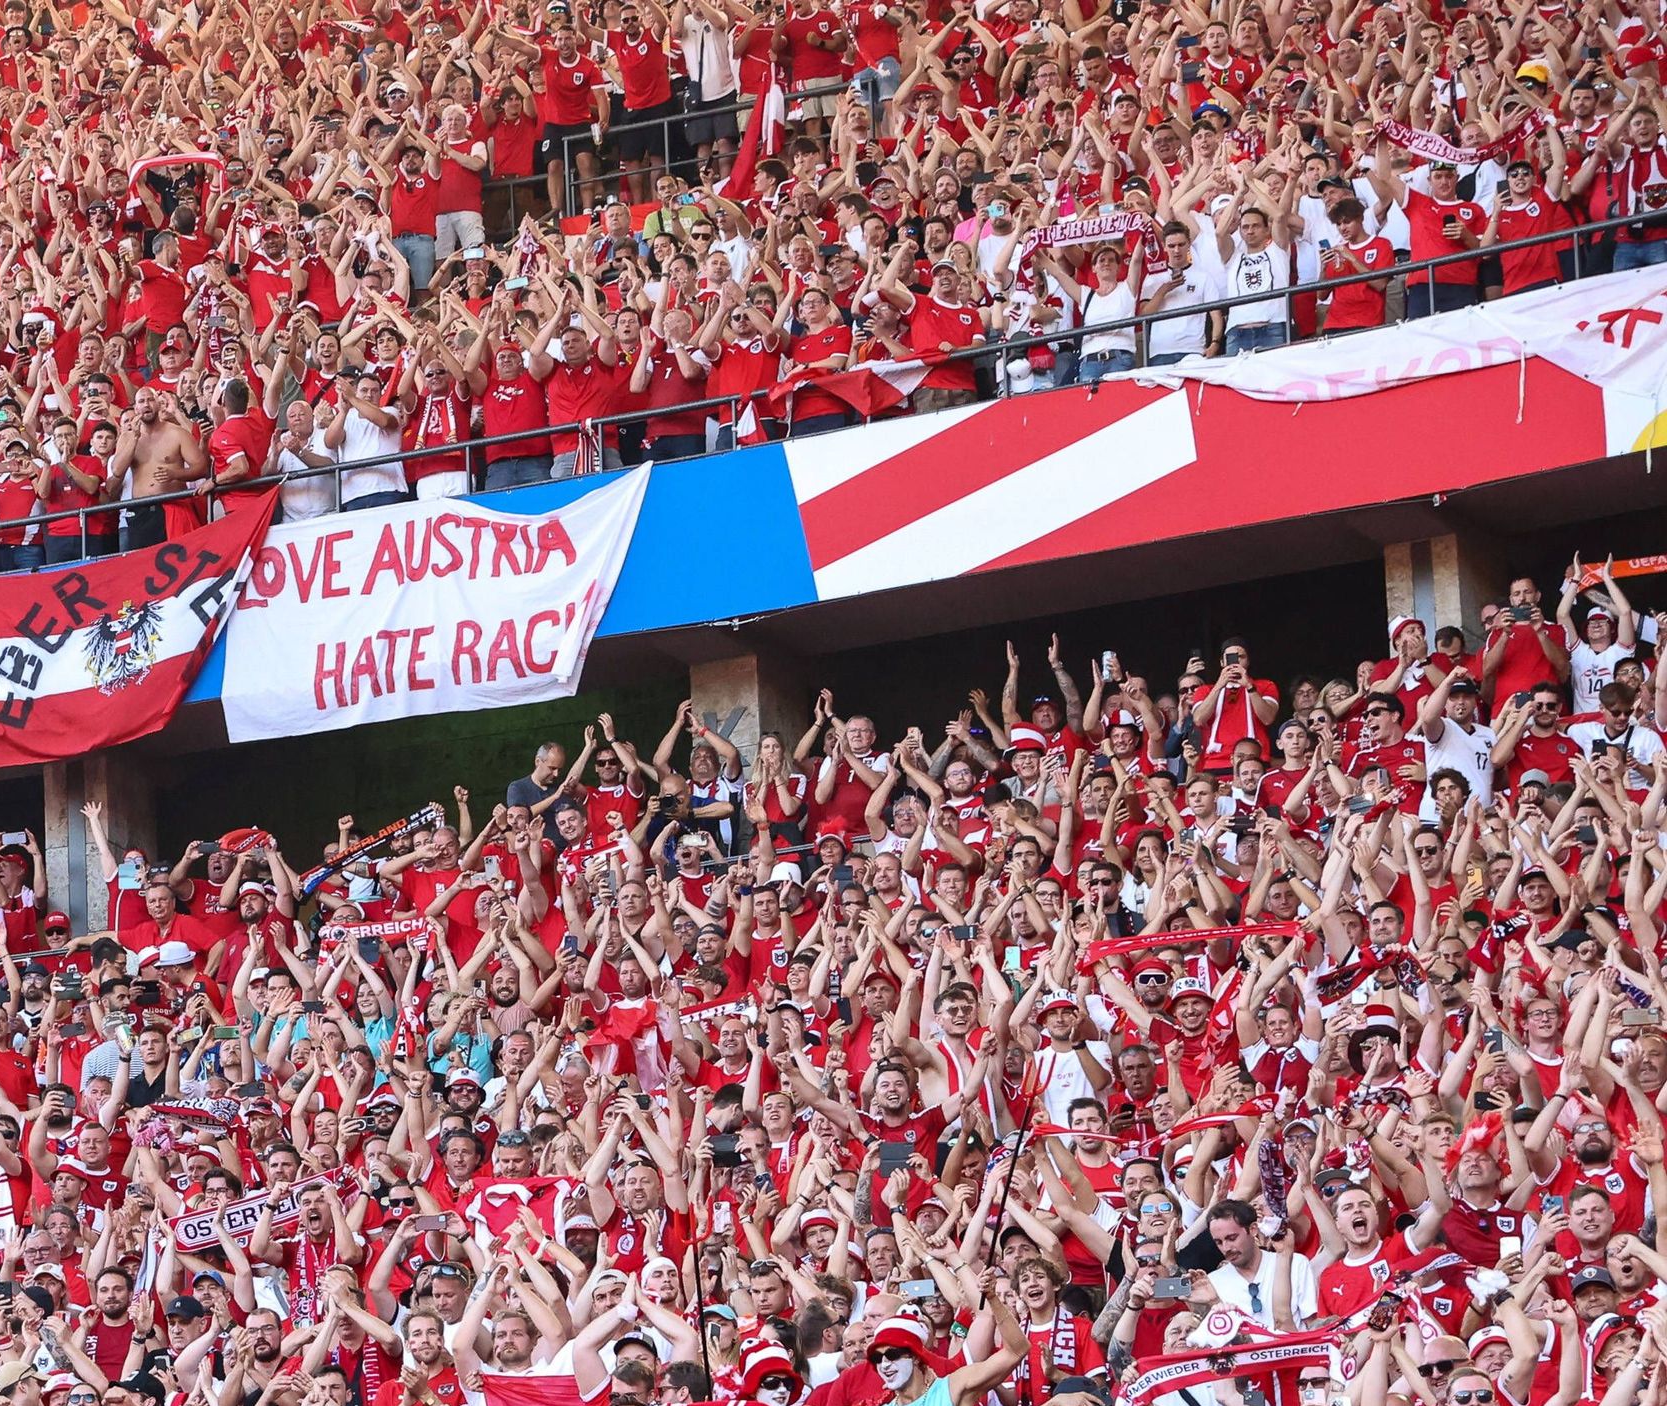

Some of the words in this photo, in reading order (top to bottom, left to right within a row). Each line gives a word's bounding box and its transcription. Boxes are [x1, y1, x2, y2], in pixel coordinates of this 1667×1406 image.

[367, 511, 577, 587] AUSTRIA
[314, 625, 436, 711] HATE
[1151, 1361, 1200, 1388] WIEDER
